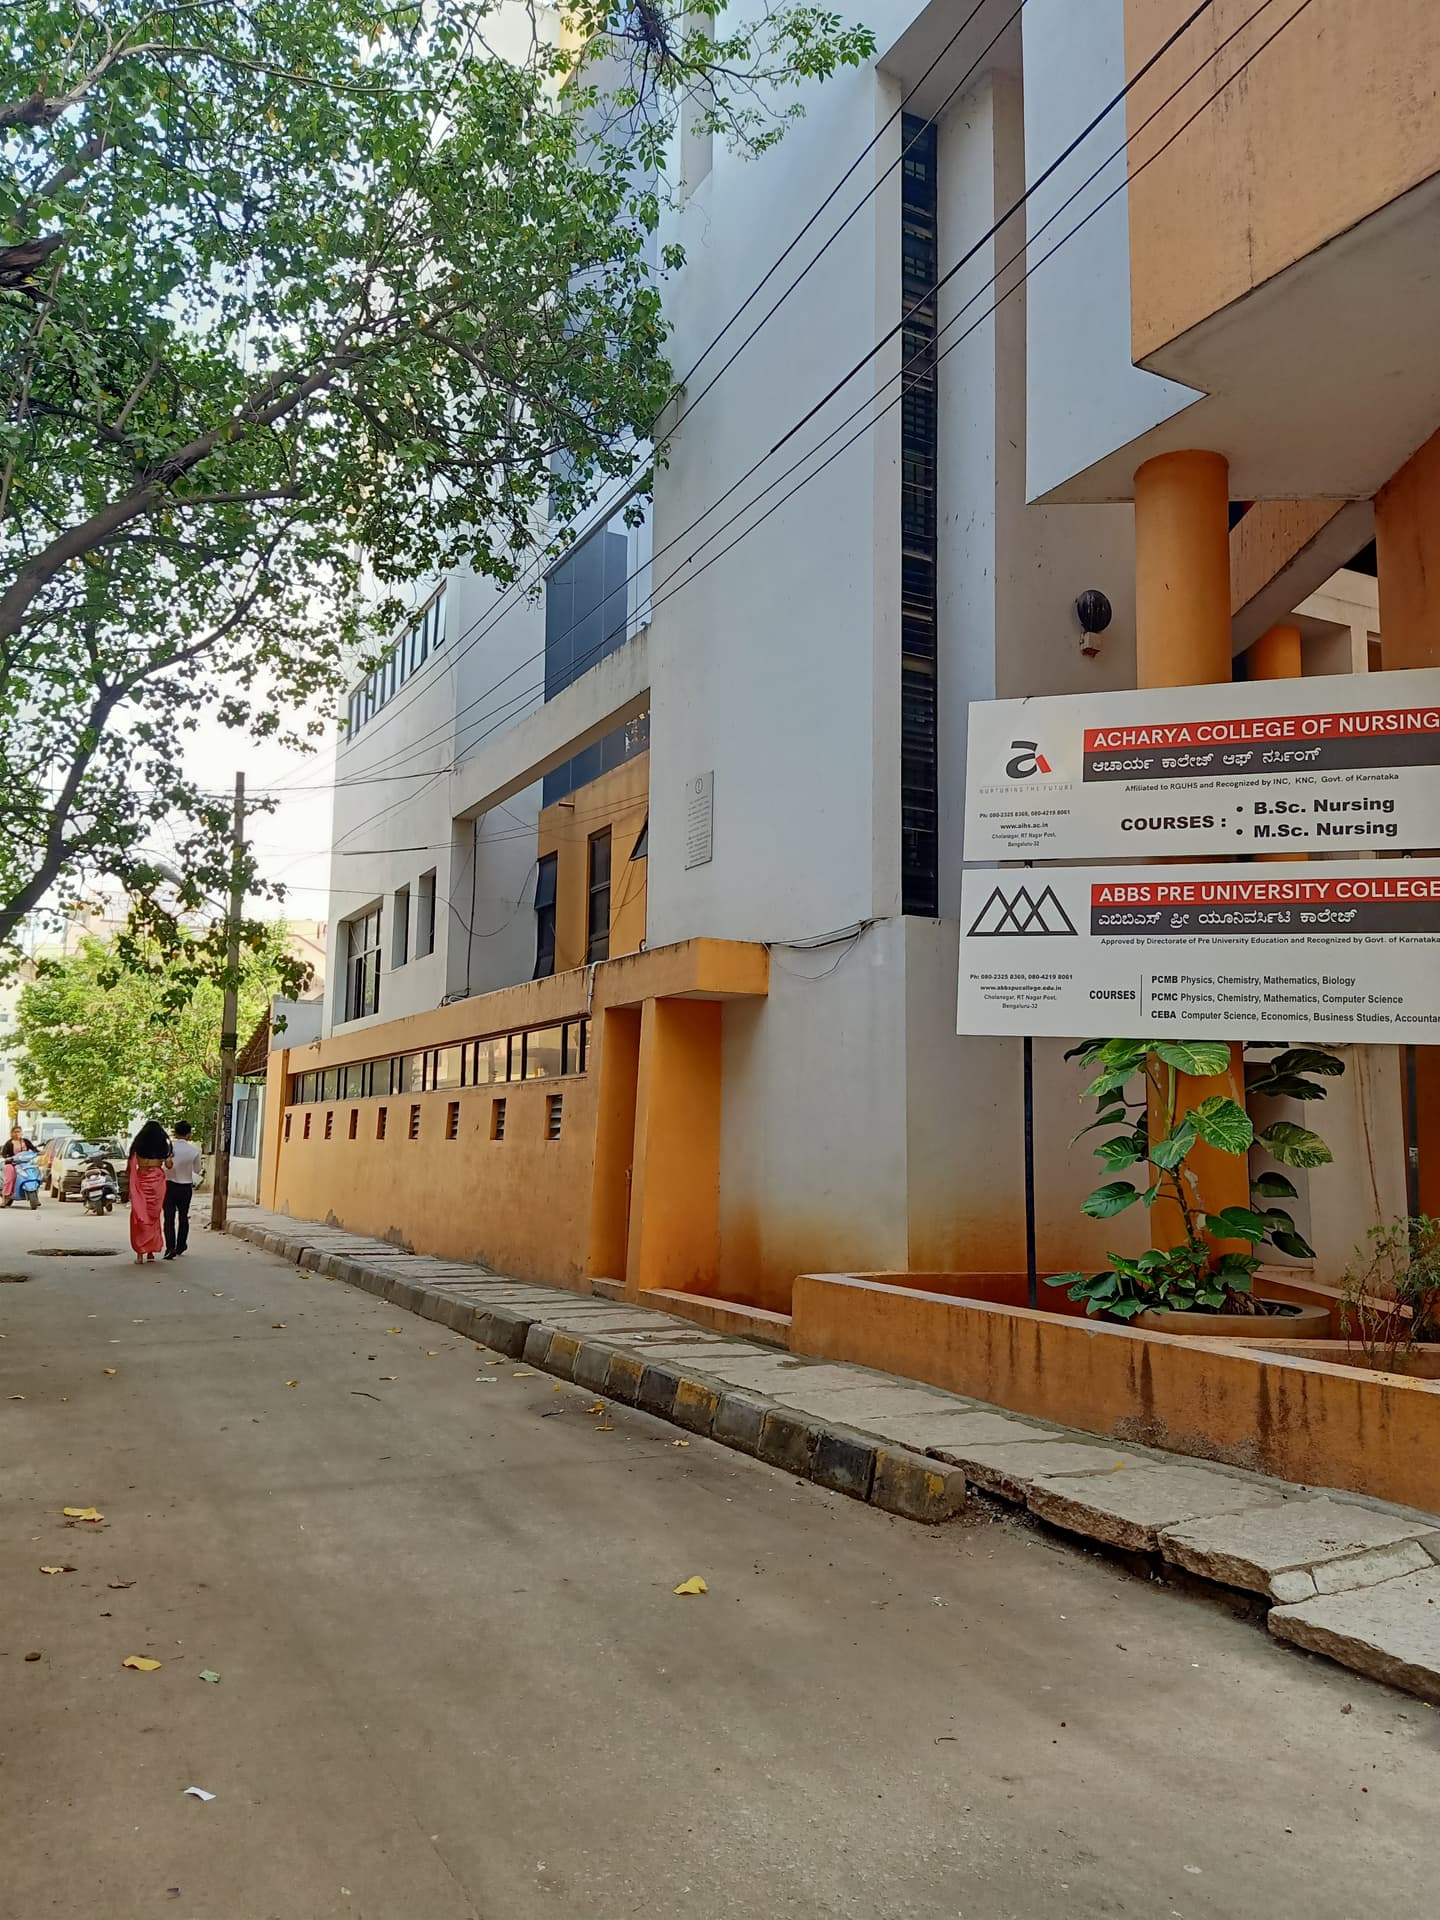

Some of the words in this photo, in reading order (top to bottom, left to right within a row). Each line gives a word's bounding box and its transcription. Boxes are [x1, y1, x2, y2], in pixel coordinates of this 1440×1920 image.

[1094, 728, 1191, 747] ACHARYA
[1197, 721, 1295, 741] COLLEGE
[1302, 718, 1332, 735] OF
[1339, 712, 1440, 733] NURSING
[1092, 757, 1154, 772] ಆಚಾರ್ಯ
[1162, 753, 1214, 768] ಕಾಲೇಜ್
[1223, 751, 1254, 767] ಆಫ್
[1262, 747, 1322, 764] ನರ್ಸಿಂಗ್
[1125, 783, 1159, 792] Affiliated
[1170, 782, 1198, 790] RGUHS
[1199, 781, 1213, 789] and
[1216, 779, 1260, 789] Recognized
[1261, 779, 1271, 787] by
[1273, 777, 1291, 785] INC,
[1295, 776, 1317, 784] KNC,
[1254, 800, 1306, 815] B.Sc.
[1313, 798, 1395, 813] Nursing
[1121, 815, 1214, 831] COURSES
[1254, 824, 1309, 838] M.Sc.
[1316, 821, 1398, 837] Nursing
[1099, 886, 1151, 902] ABBS
[1157, 885, 1195, 901] PRE
[1201, 883, 1330, 901] UNIVERSITY
[1336, 881, 1440, 898] COLLEGE
[1098, 912, 1162, 925] ಎಬಿಬಿಎಸ್
[1198, 910, 1291, 924] ಯೂನಿವರ್ಸಿಟಿ
[1300, 908, 1358, 923] ಕಾಲೇಜ್
[1101, 938, 1134, 946] Approved
[1136, 937, 1145, 946] by
[1211, 937, 1249, 946] University
[1291, 936, 1305, 944] and
[1307, 936, 1350, 945] Recognized
[1353, 936, 1363, 944] by
[1151, 975, 1178, 984] PCMB
[1181, 975, 1215, 986] Physics,
[1217, 976, 1261, 986] Chemistry,
[1263, 976, 1320, 986] Mathematics,
[1322, 976, 1355, 987] Biology
[1089, 990, 1136, 1000] COURSES
[1151, 993, 1178, 1001] PCMC
[1181, 993, 1215, 1003] Physics,
[1217, 993, 1262, 1004] Chemistry,
[1263, 993, 1320, 1004] Mathematics,
[1322, 994, 1365, 1005] Computer
[1368, 995, 1403, 1004] Science
[1151, 1010, 1177, 1019] CEBA
[1181, 1011, 1221, 1021] Computer
[1223, 1011, 1258, 1021] Science,
[1261, 1012, 1311, 1022] Economics,
[1313, 1013, 1354, 1022] Business
[1356, 1013, 1392, 1023] Studies,
